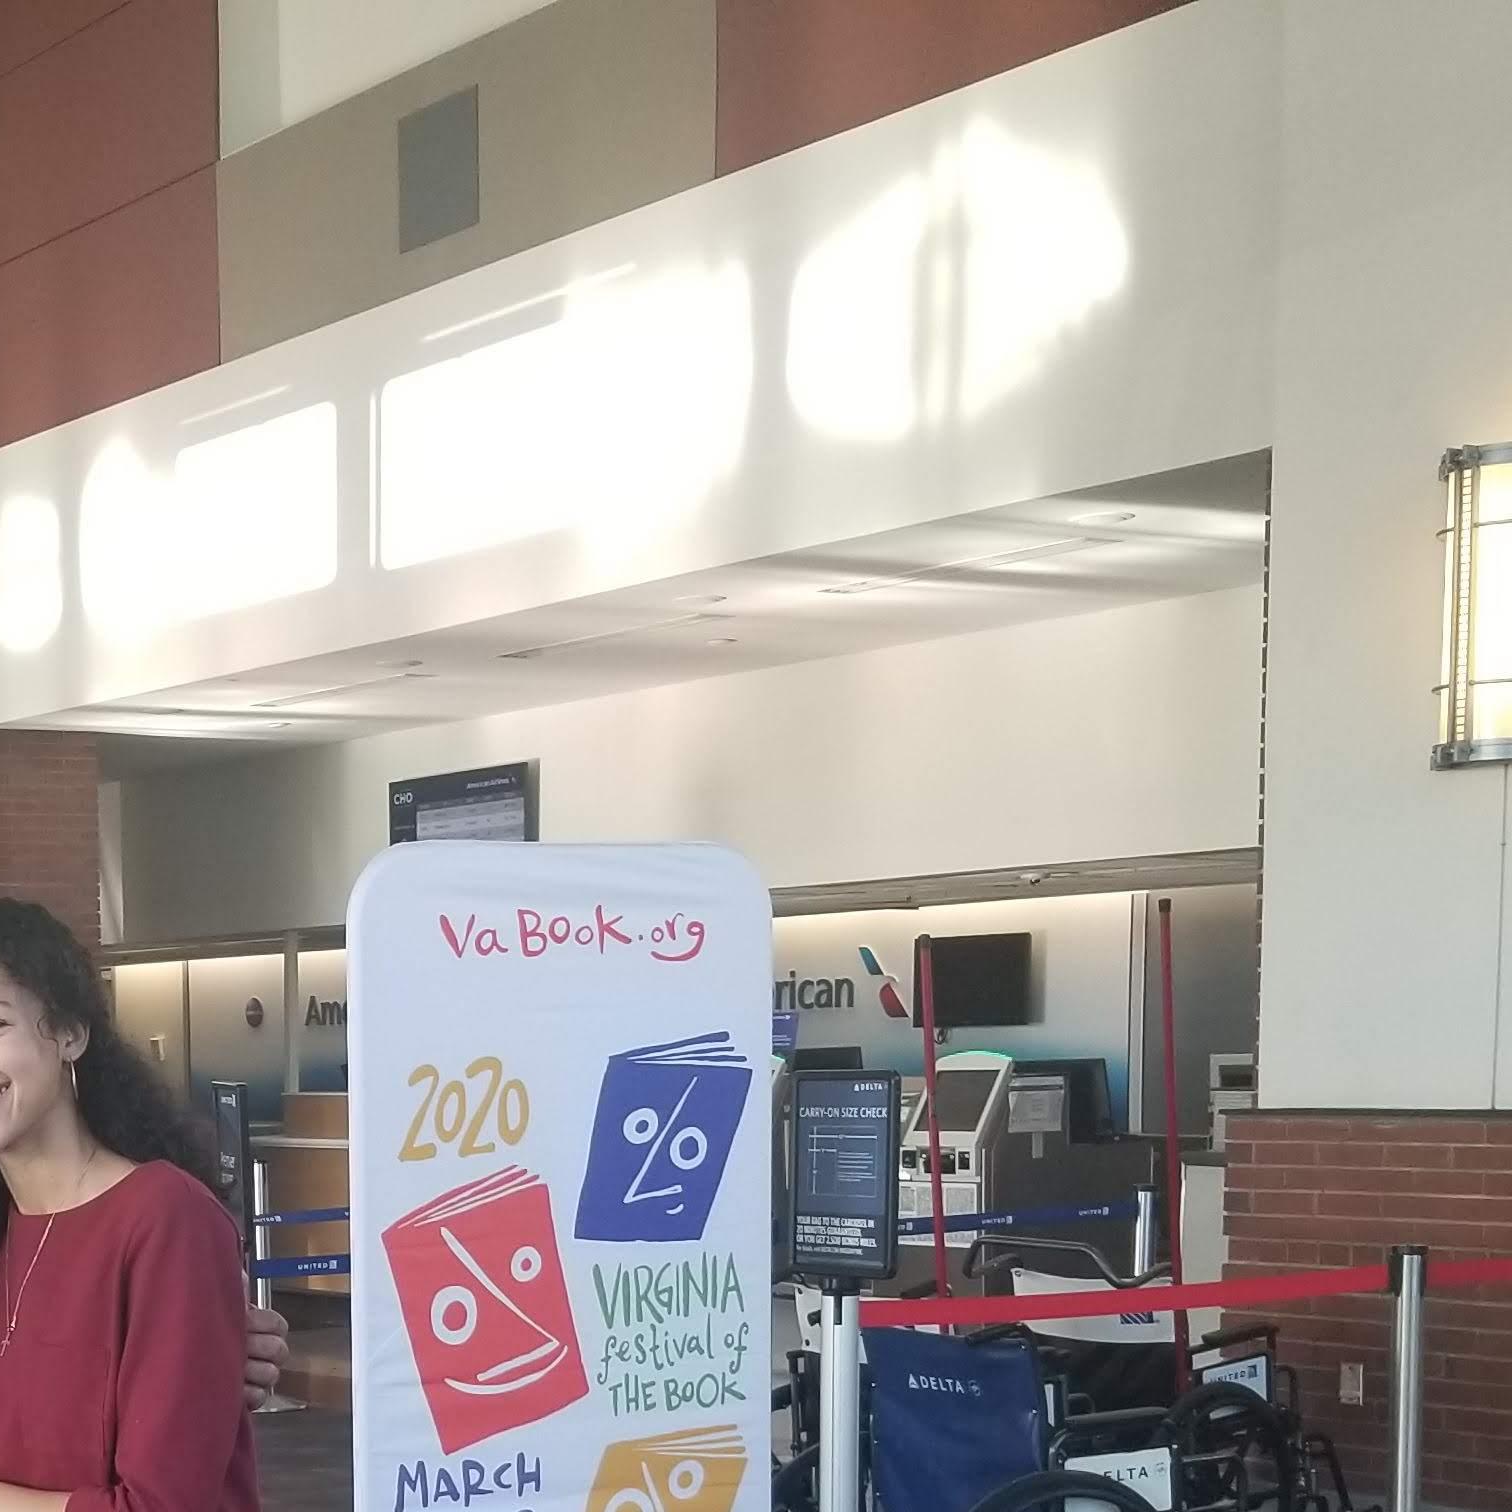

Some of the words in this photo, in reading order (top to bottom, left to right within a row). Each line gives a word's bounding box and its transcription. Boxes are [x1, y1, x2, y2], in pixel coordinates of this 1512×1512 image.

[393, 792, 414, 805] CHO
[773, 969, 854, 1010] rican
[304, 995, 347, 1026] Am
[860, 1083, 883, 1091] DELTA
[397, 1056, 530, 1162] 2020
[799, 1106, 840, 1118] CARRY-ON
[841, 1106, 859, 1118] SIZE
[860, 1106, 888, 1118] CHECK
[297, 1262, 329, 1271] UNITED
[592, 1252, 745, 1329] VIRGINIA
[597, 1313, 714, 1385] festival
[724, 1321, 750, 1375] of
[608, 1374, 657, 1417] THE
[919, 1375, 965, 1394] DELTA
[1103, 1465, 1149, 1481] ELTA
